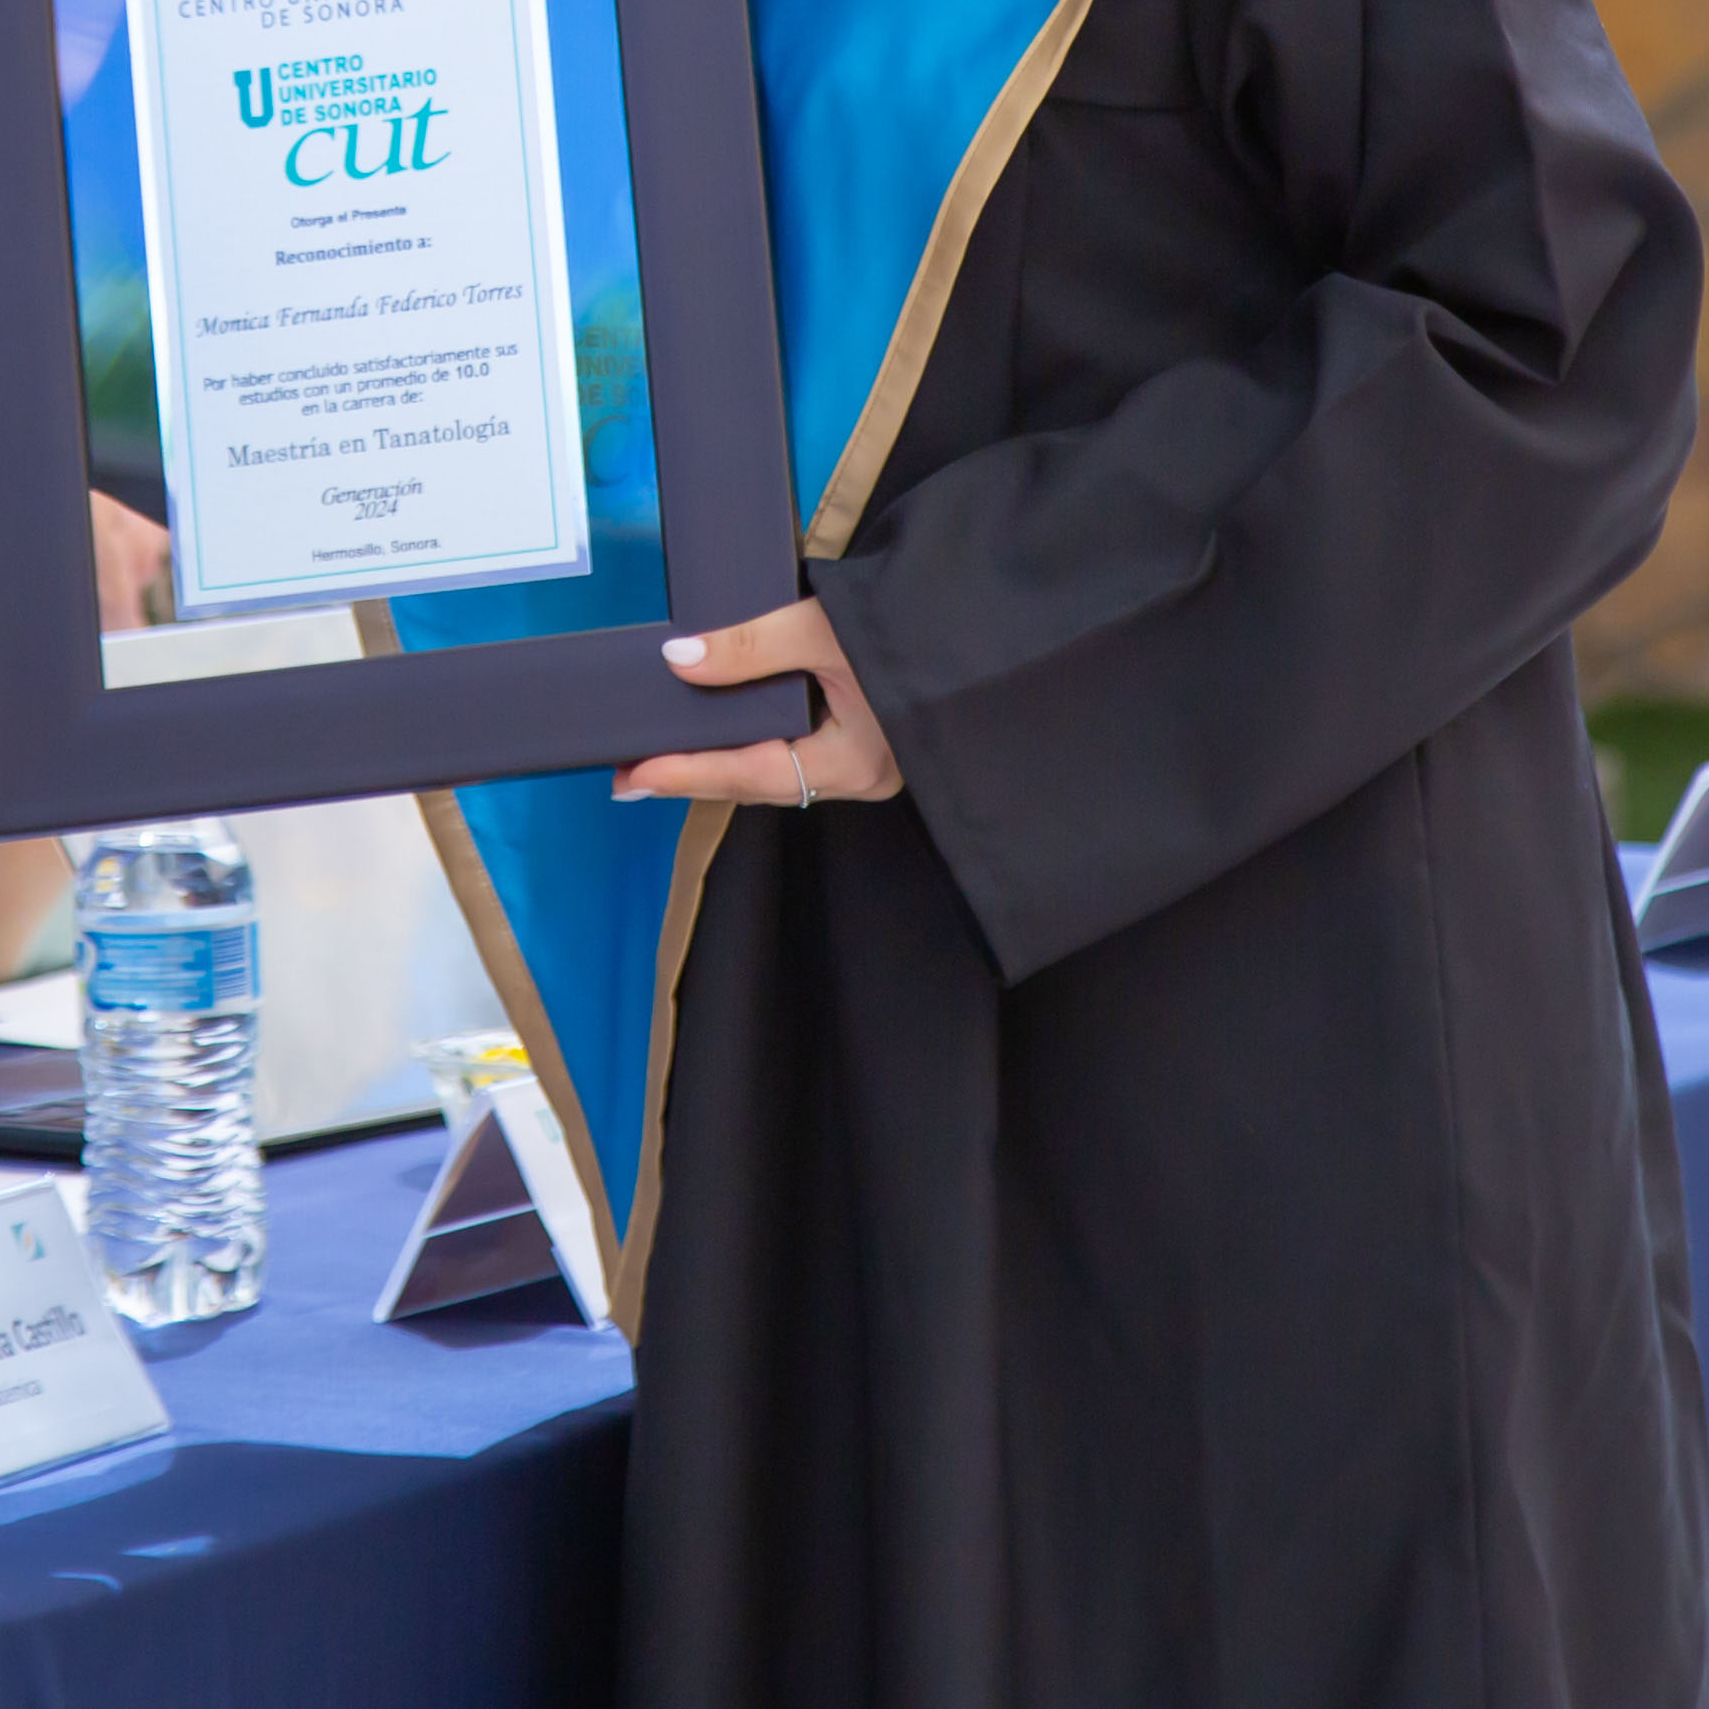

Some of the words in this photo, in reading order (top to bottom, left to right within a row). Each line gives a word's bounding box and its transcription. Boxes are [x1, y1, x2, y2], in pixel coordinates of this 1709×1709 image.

[261, 9, 290, 29] DE
[278, 54, 364, 80] CENTRO
[233, 67, 274, 129] U
[279, 68, 437, 103] UNIVERSITARIO
[281, 107, 307, 126] DE
[314, 96, 402, 123] SONORA
[284, 97, 452, 187] cut
[290, 214, 334, 230] Otorga
[352, 205, 407, 221] Presente
[275, 238, 412, 266] Reconocimiento
[417, 236, 433, 250] a:
[276, 296, 369, 328] Fernanda
[375, 289, 458, 316] Federico
[462, 282, 524, 306] Torres
[203, 377, 226, 392] Por
[231, 371, 274, 389] haber
[278, 364, 349, 384] concluido
[352, 346, 491, 375] satisfactoriamente
[495, 343, 518, 358] sus
[239, 386, 299, 406] estudios
[303, 384, 329, 399] con
[334, 381, 352, 394] un
[357, 371, 427, 394] promedio
[431, 367, 449, 383] de
[456, 362, 490, 381] 10.0
[301, 401, 319, 416] en
[324, 398, 338, 414] la
[342, 390, 396, 413] carrera
[400, 389, 424, 406] de:
[227, 436, 331, 468] Maestría
[338, 436, 367, 455] en
[373, 414, 511, 451] Tanatología
[321, 476, 424, 506] Generación
[354, 498, 399, 521] 2024
